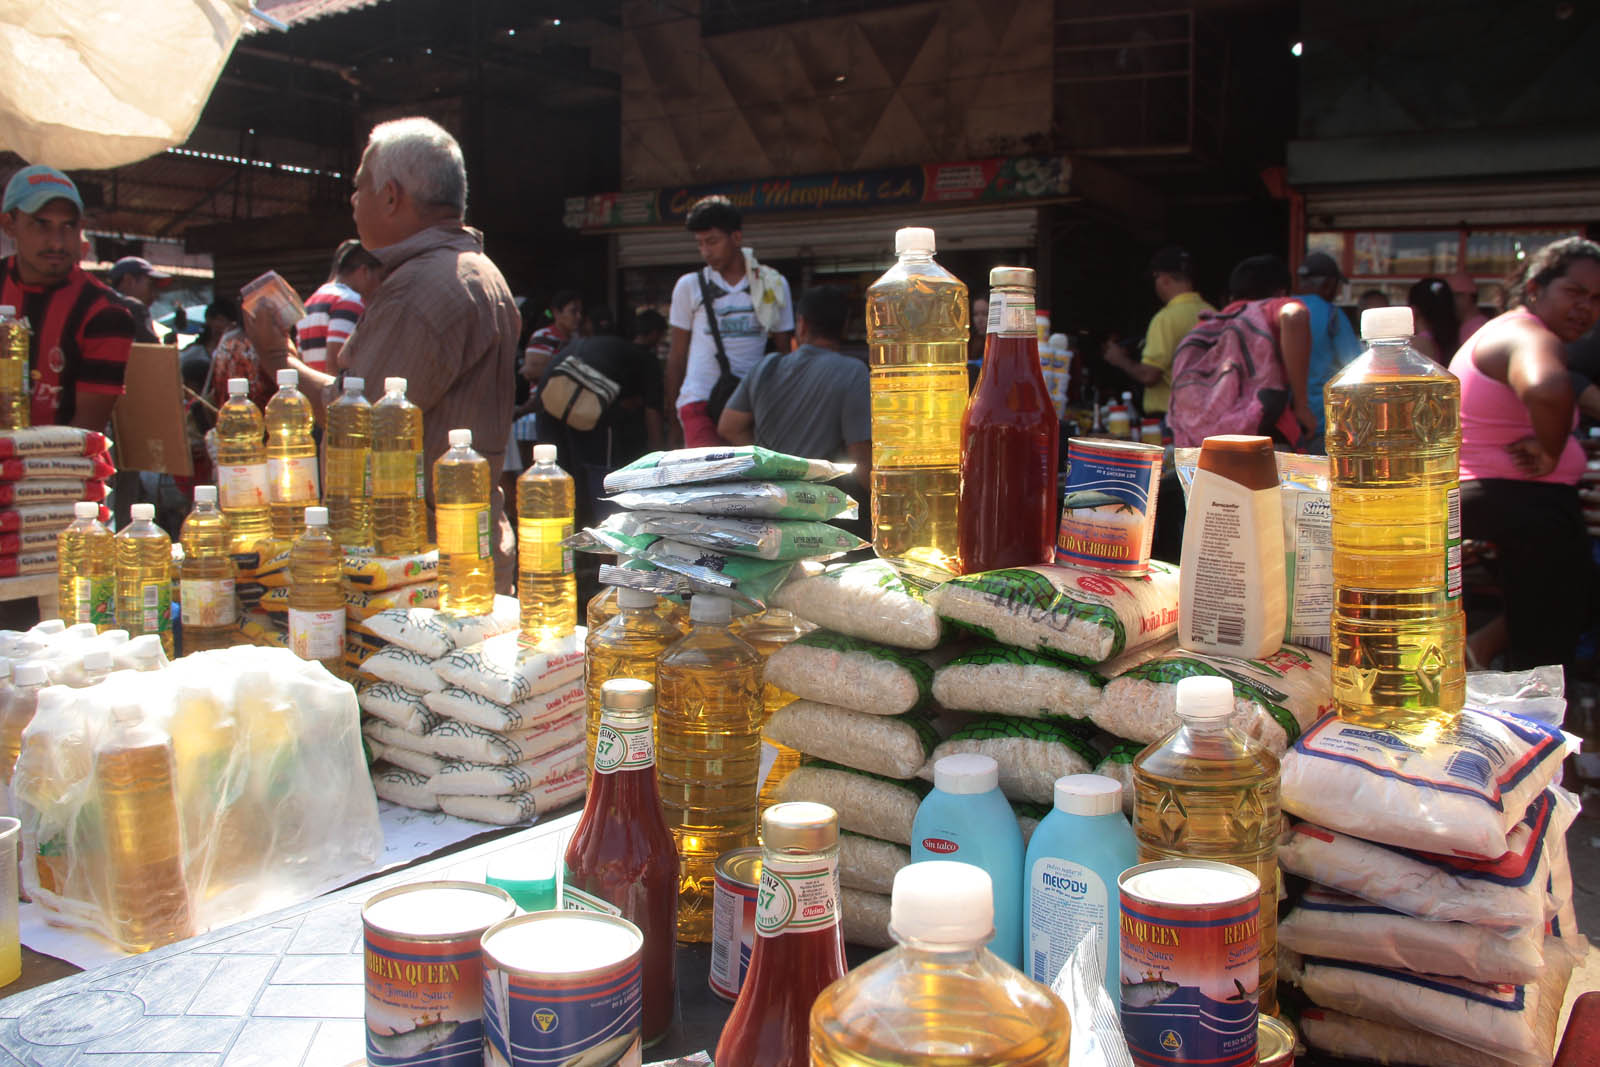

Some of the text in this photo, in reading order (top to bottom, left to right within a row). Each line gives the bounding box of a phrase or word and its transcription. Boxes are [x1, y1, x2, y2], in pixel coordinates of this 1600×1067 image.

[1076, 540, 1130, 559] CARIBBEAN
[1139, 609, 1160, 636] Doña
[598, 740, 614, 756] 57
[924, 839, 956, 851] Sin talco
[758, 889, 776, 910] 57
[1136, 923, 1180, 947] QUEEN
[405, 963, 460, 987] QUEEN
[421, 987, 455, 1005] Sauce
